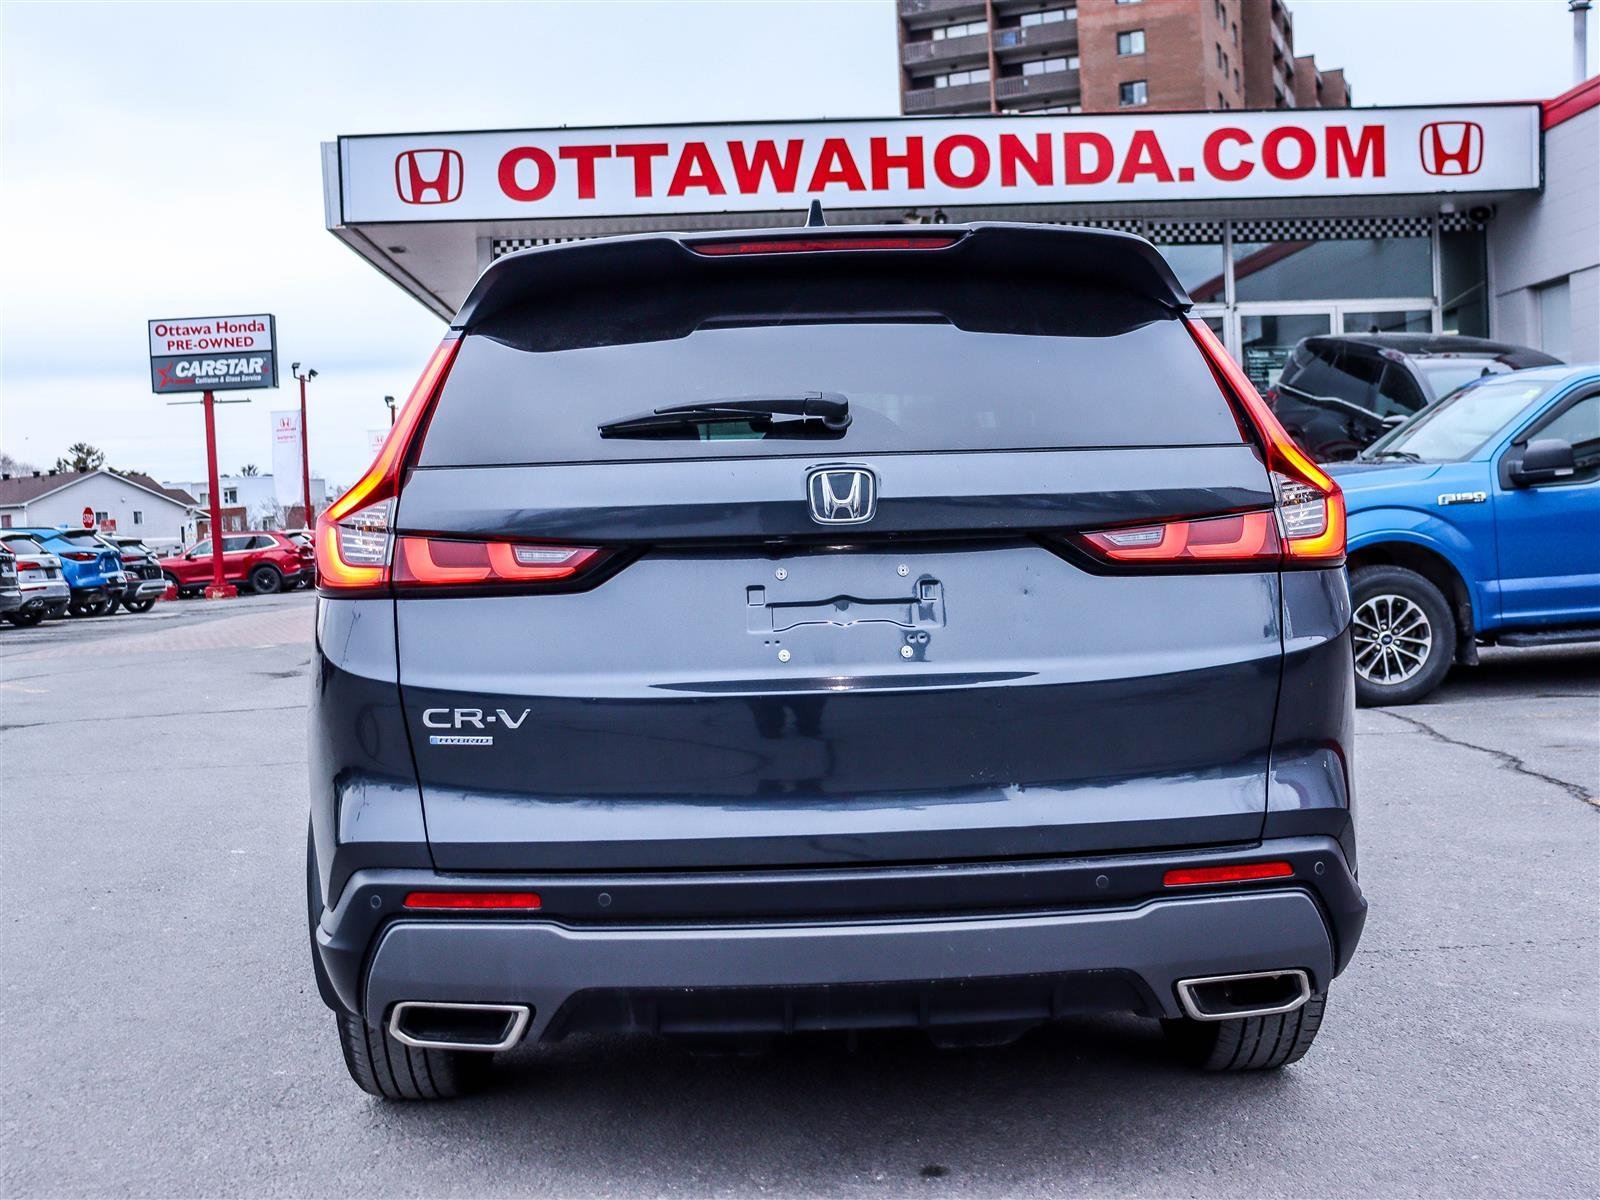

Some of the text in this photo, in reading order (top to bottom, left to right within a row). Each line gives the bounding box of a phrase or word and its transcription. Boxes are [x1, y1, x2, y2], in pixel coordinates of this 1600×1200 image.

[498, 124, 1387, 203] OTTAWAHONDA.COM
[155, 320, 265, 337] Ottawa Honda
[167, 336, 254, 351] PRE-OWNED
[175, 357, 264, 378] CARSTAR
[82, 513, 94, 523] STOP
[422, 708, 531, 728] CR-V
